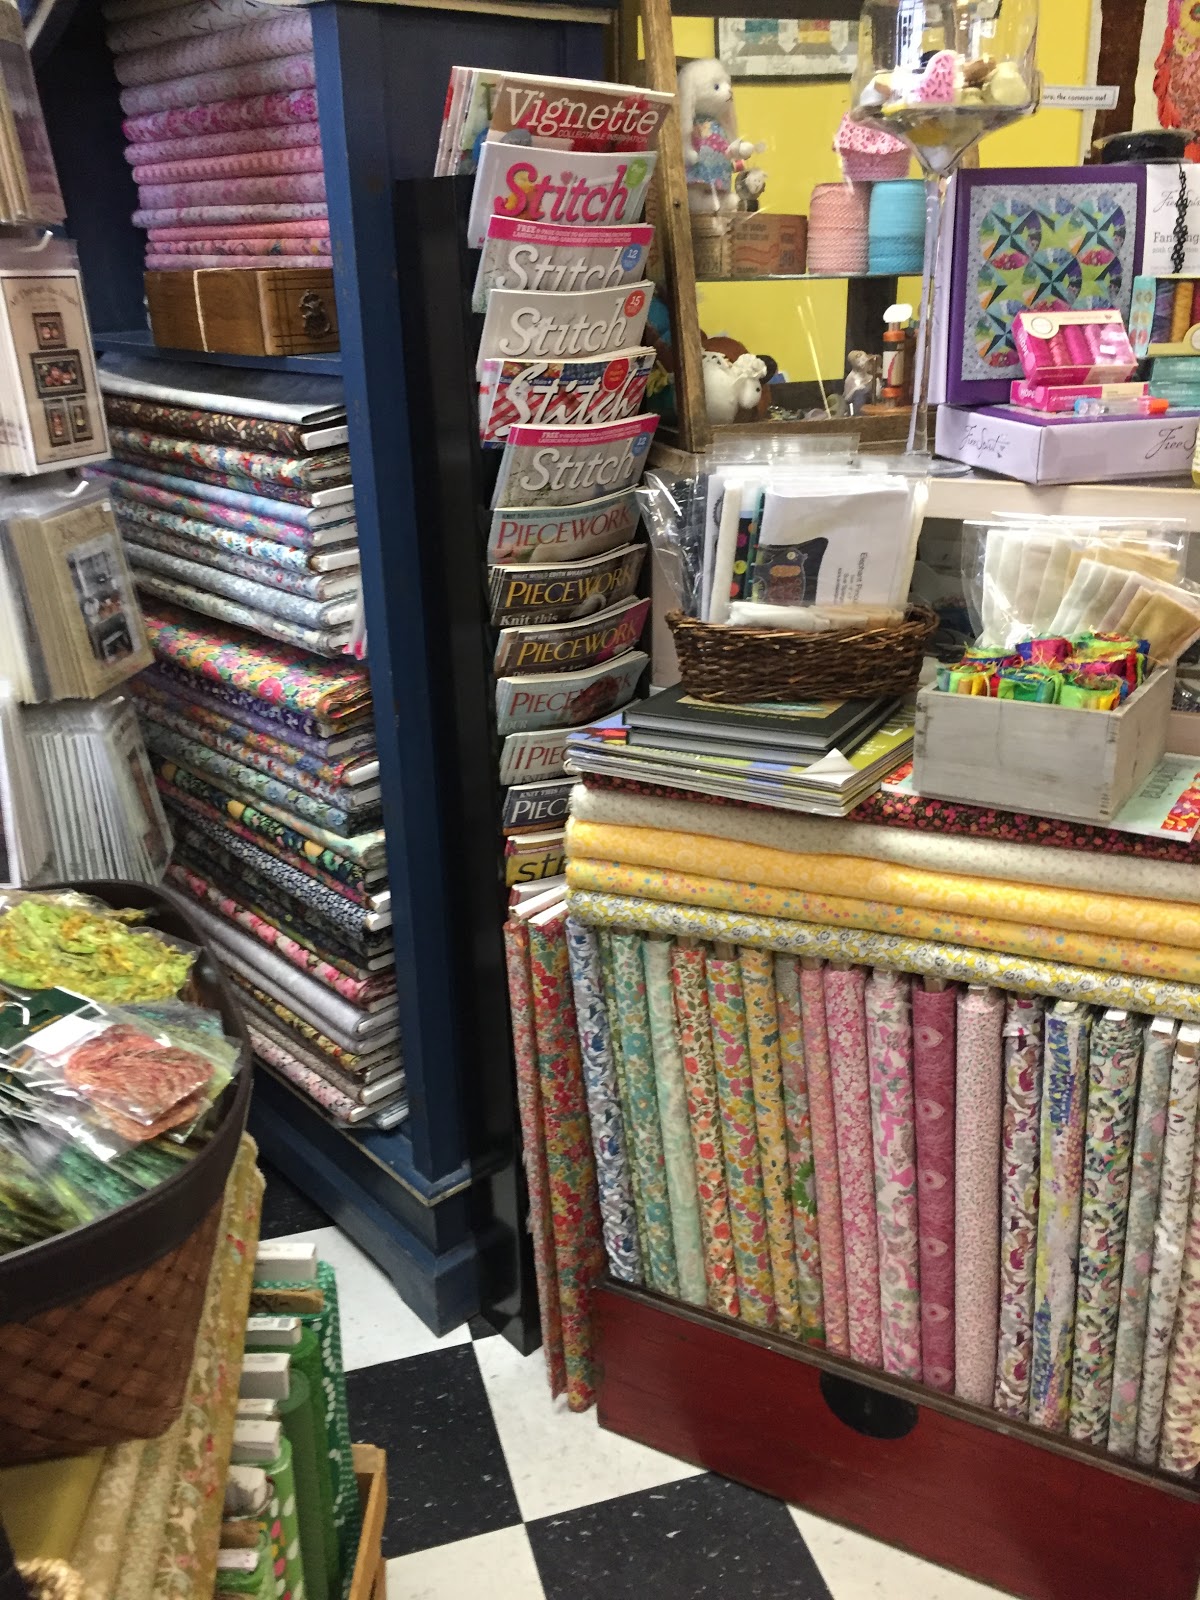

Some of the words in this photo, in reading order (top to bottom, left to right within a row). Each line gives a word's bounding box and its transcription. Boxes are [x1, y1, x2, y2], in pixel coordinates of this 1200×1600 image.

[506, 87, 659, 136] Vignette
[494, 162, 629, 222] Stitch
[496, 244, 625, 291] Stitch
[627, 249, 639, 258] 12
[630, 295, 641, 306] 15
[501, 298, 628, 356] Stitch
[495, 362, 638, 437] Stitch
[637, 437, 646, 445] 12
[520, 439, 634, 491] Stitch
[497, 506, 631, 549] PIECEWORK
[505, 566, 634, 608] PIECEWORK
[500, 614, 531, 626] Knit
[534, 613, 559, 624] this
[517, 620, 637, 666] PIECEWORK
